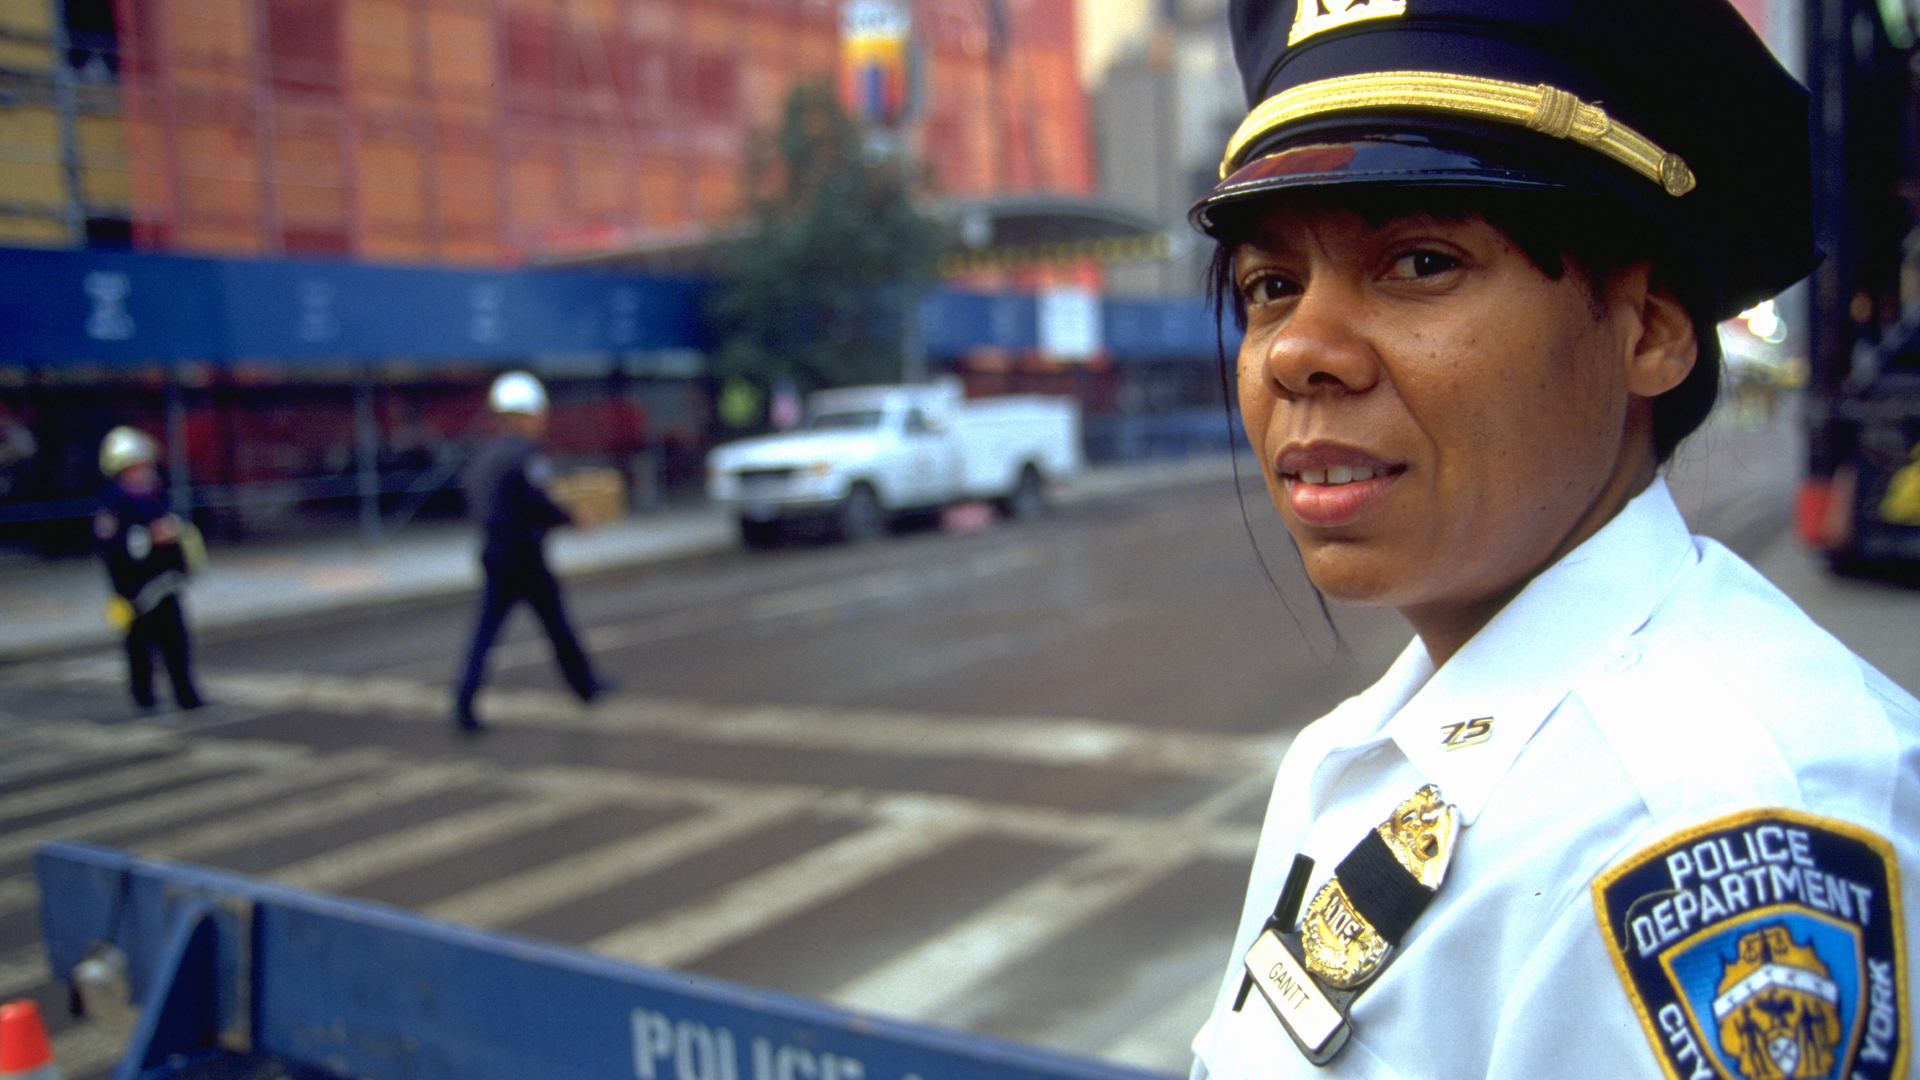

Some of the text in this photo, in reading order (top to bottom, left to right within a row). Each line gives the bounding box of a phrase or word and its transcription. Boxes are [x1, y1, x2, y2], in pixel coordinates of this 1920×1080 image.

[1440, 716, 1494, 747] 75
[1665, 826, 1814, 891] POLICE
[1631, 864, 1873, 957] DEPARTMENT
[1268, 962, 1310, 1010] GANTT
[1860, 957, 1893, 1063] YORK
[1658, 1002, 1713, 1080] CITY
